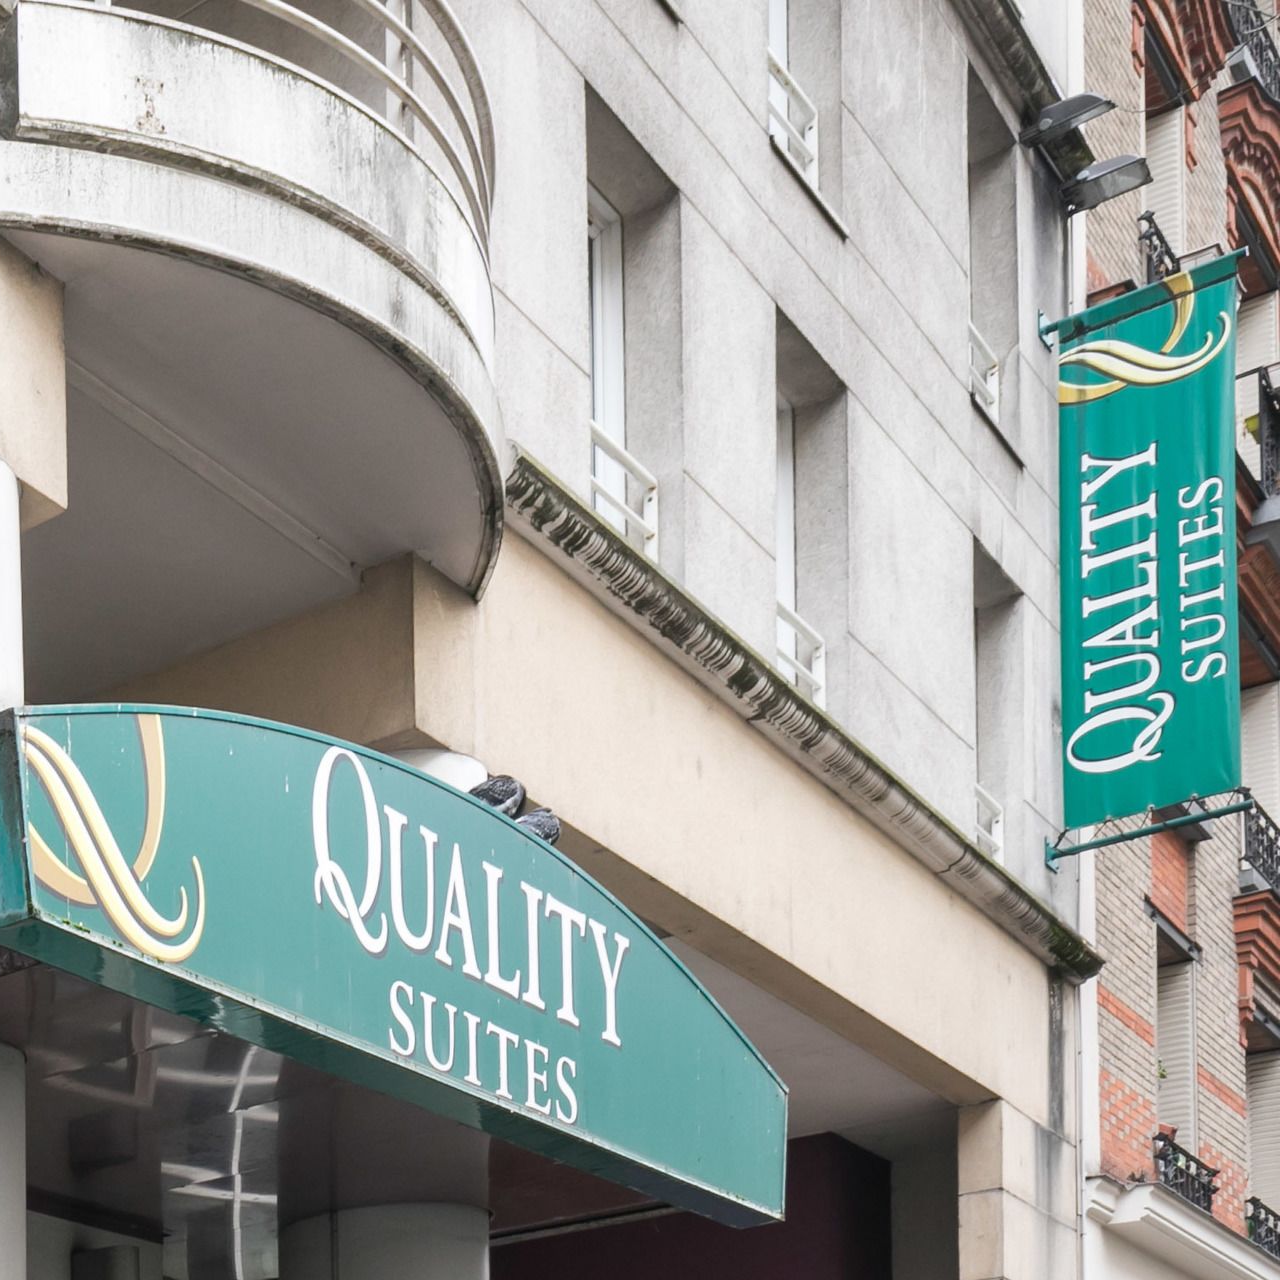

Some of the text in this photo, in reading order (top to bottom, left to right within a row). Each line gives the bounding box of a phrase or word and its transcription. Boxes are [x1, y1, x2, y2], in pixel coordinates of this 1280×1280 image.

[1067, 440, 1175, 776] QUALITY
[1176, 476, 1229, 680] SUITES
[312, 746, 631, 1048] QUALITY
[388, 980, 579, 1124] SUITES
